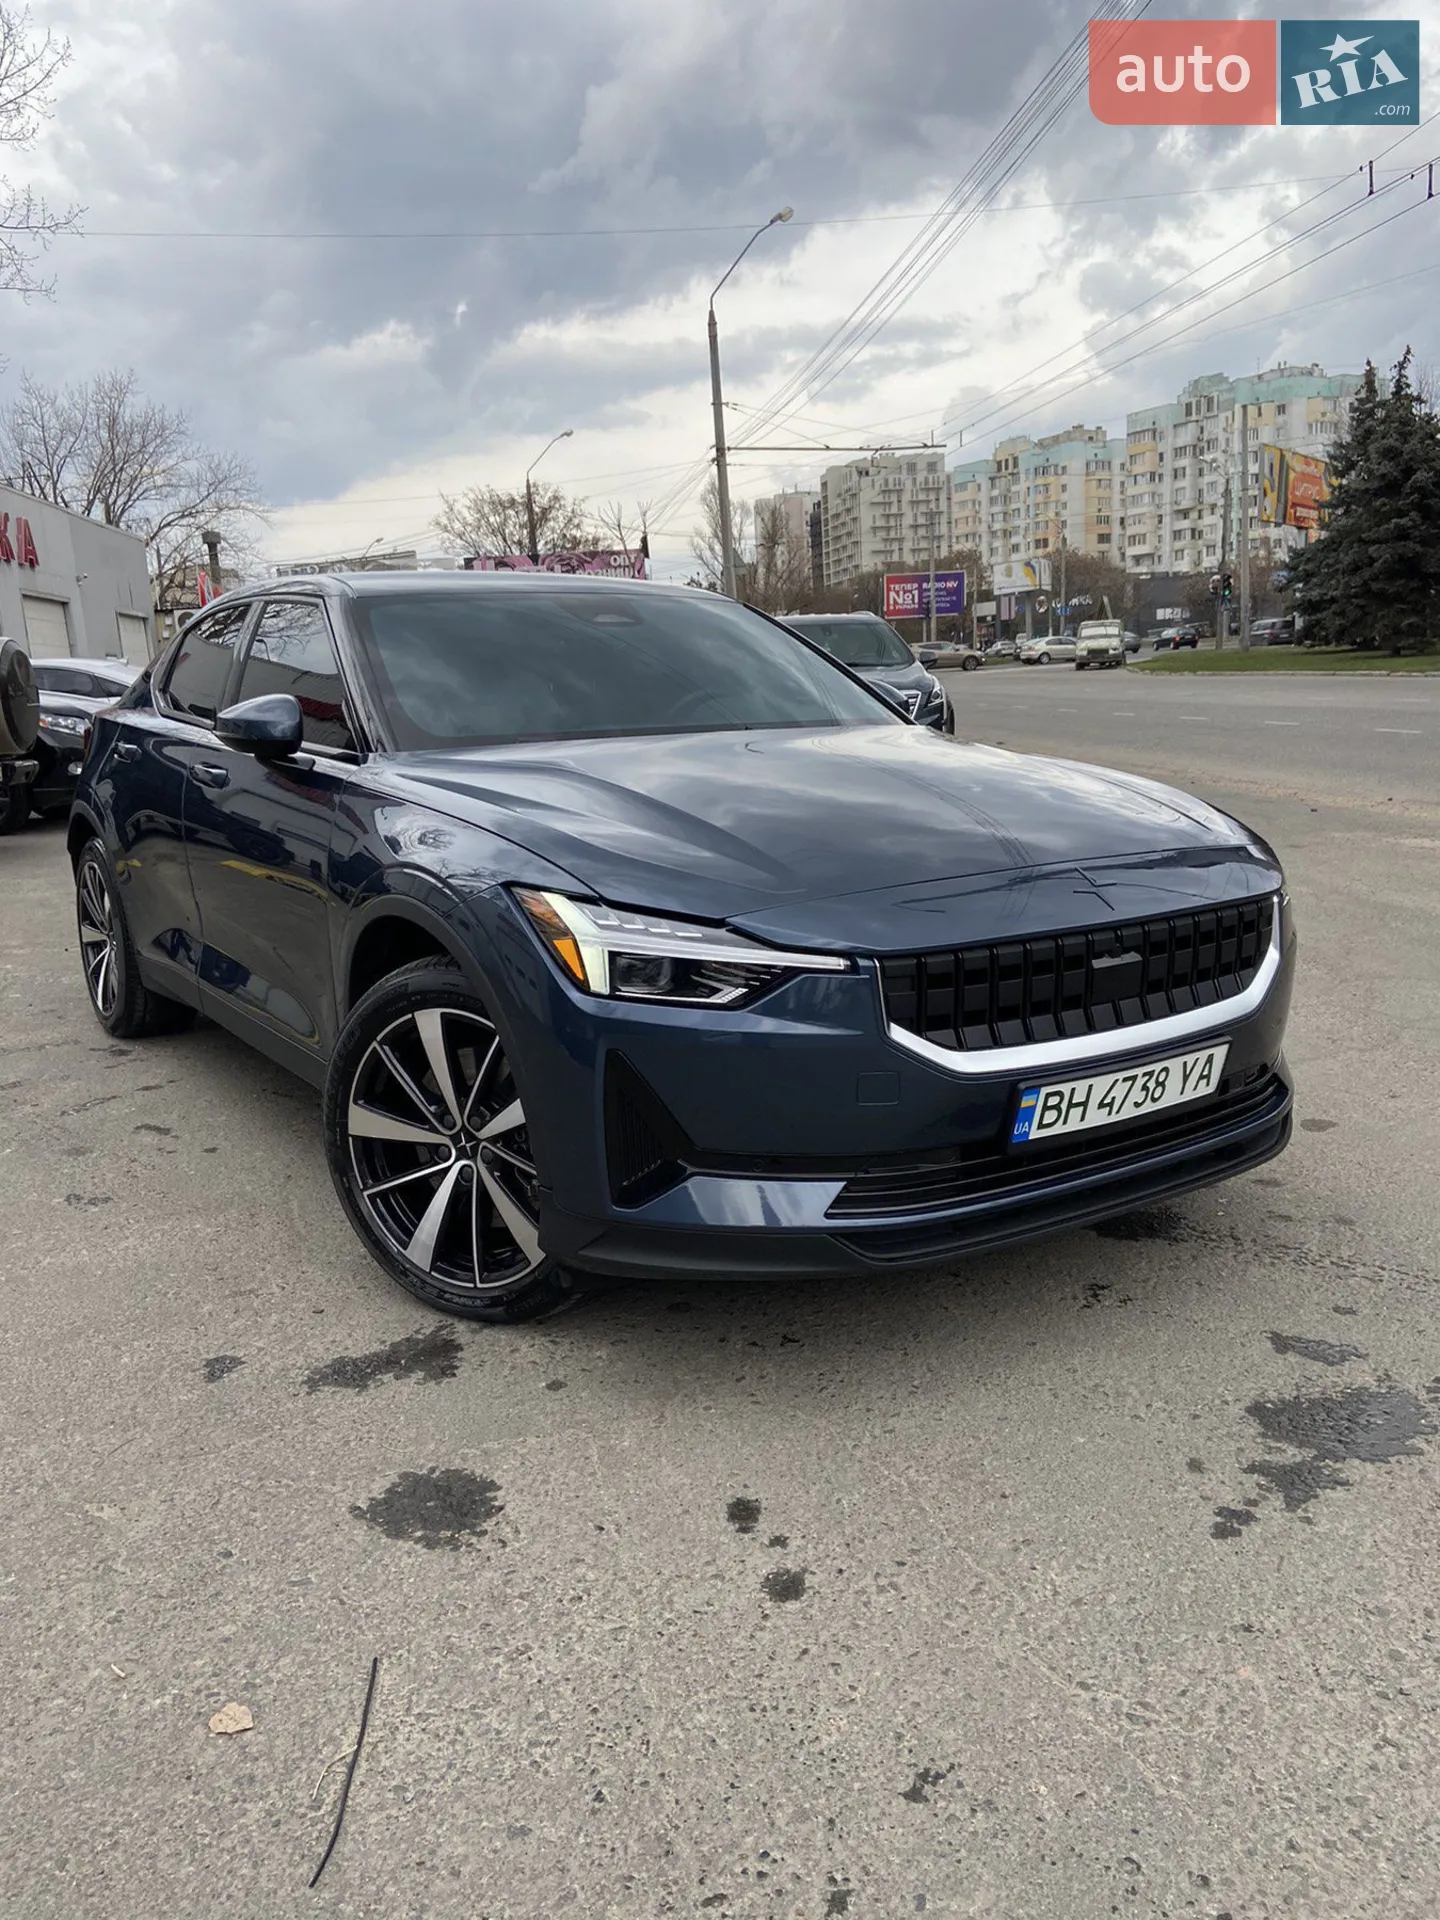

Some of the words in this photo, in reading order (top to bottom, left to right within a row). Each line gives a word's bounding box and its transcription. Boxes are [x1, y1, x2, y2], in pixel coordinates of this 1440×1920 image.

[1036, 1084, 1094, 1131] BH
[1097, 1066, 1170, 1117] 4738
[1180, 1053, 1215, 1096] YA
[1014, 1121, 1030, 1135] UA
